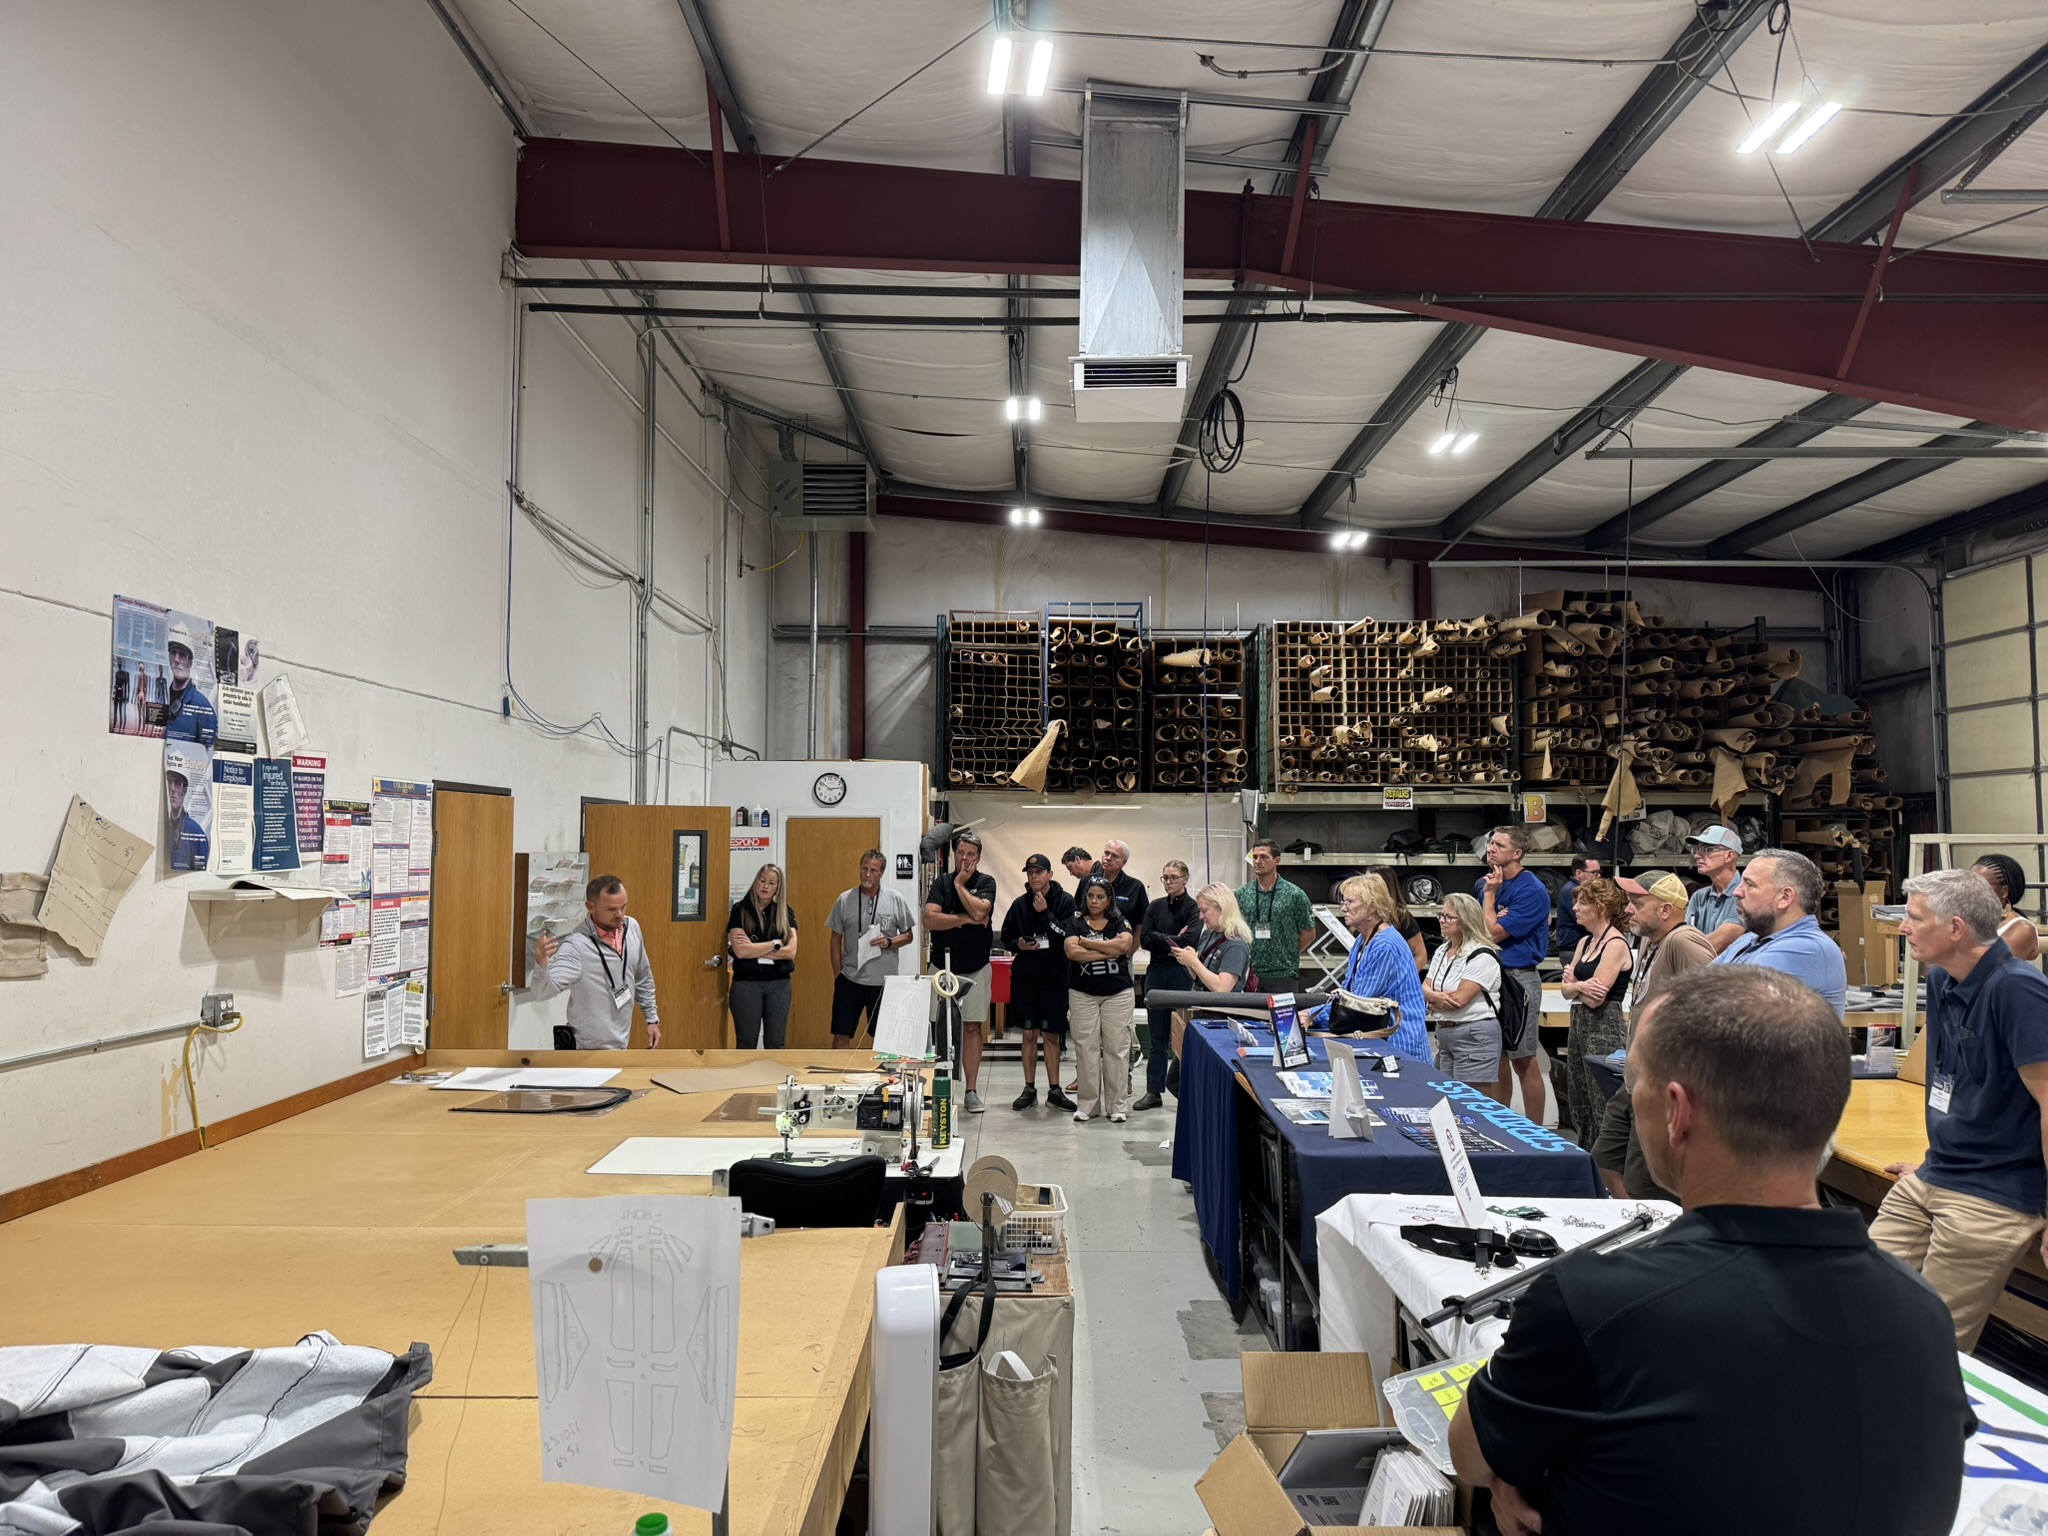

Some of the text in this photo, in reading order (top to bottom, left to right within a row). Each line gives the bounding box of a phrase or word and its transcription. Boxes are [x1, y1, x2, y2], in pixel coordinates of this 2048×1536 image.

[296, 758, 322, 768] WARNING
[262, 771, 283, 782] injured
[1385, 789, 1411, 800] REPAIRS
[1525, 795, 1545, 821] B
[939, 1097, 947, 1144] KEYSTON
[620, 1209, 663, 1223] FRONT
